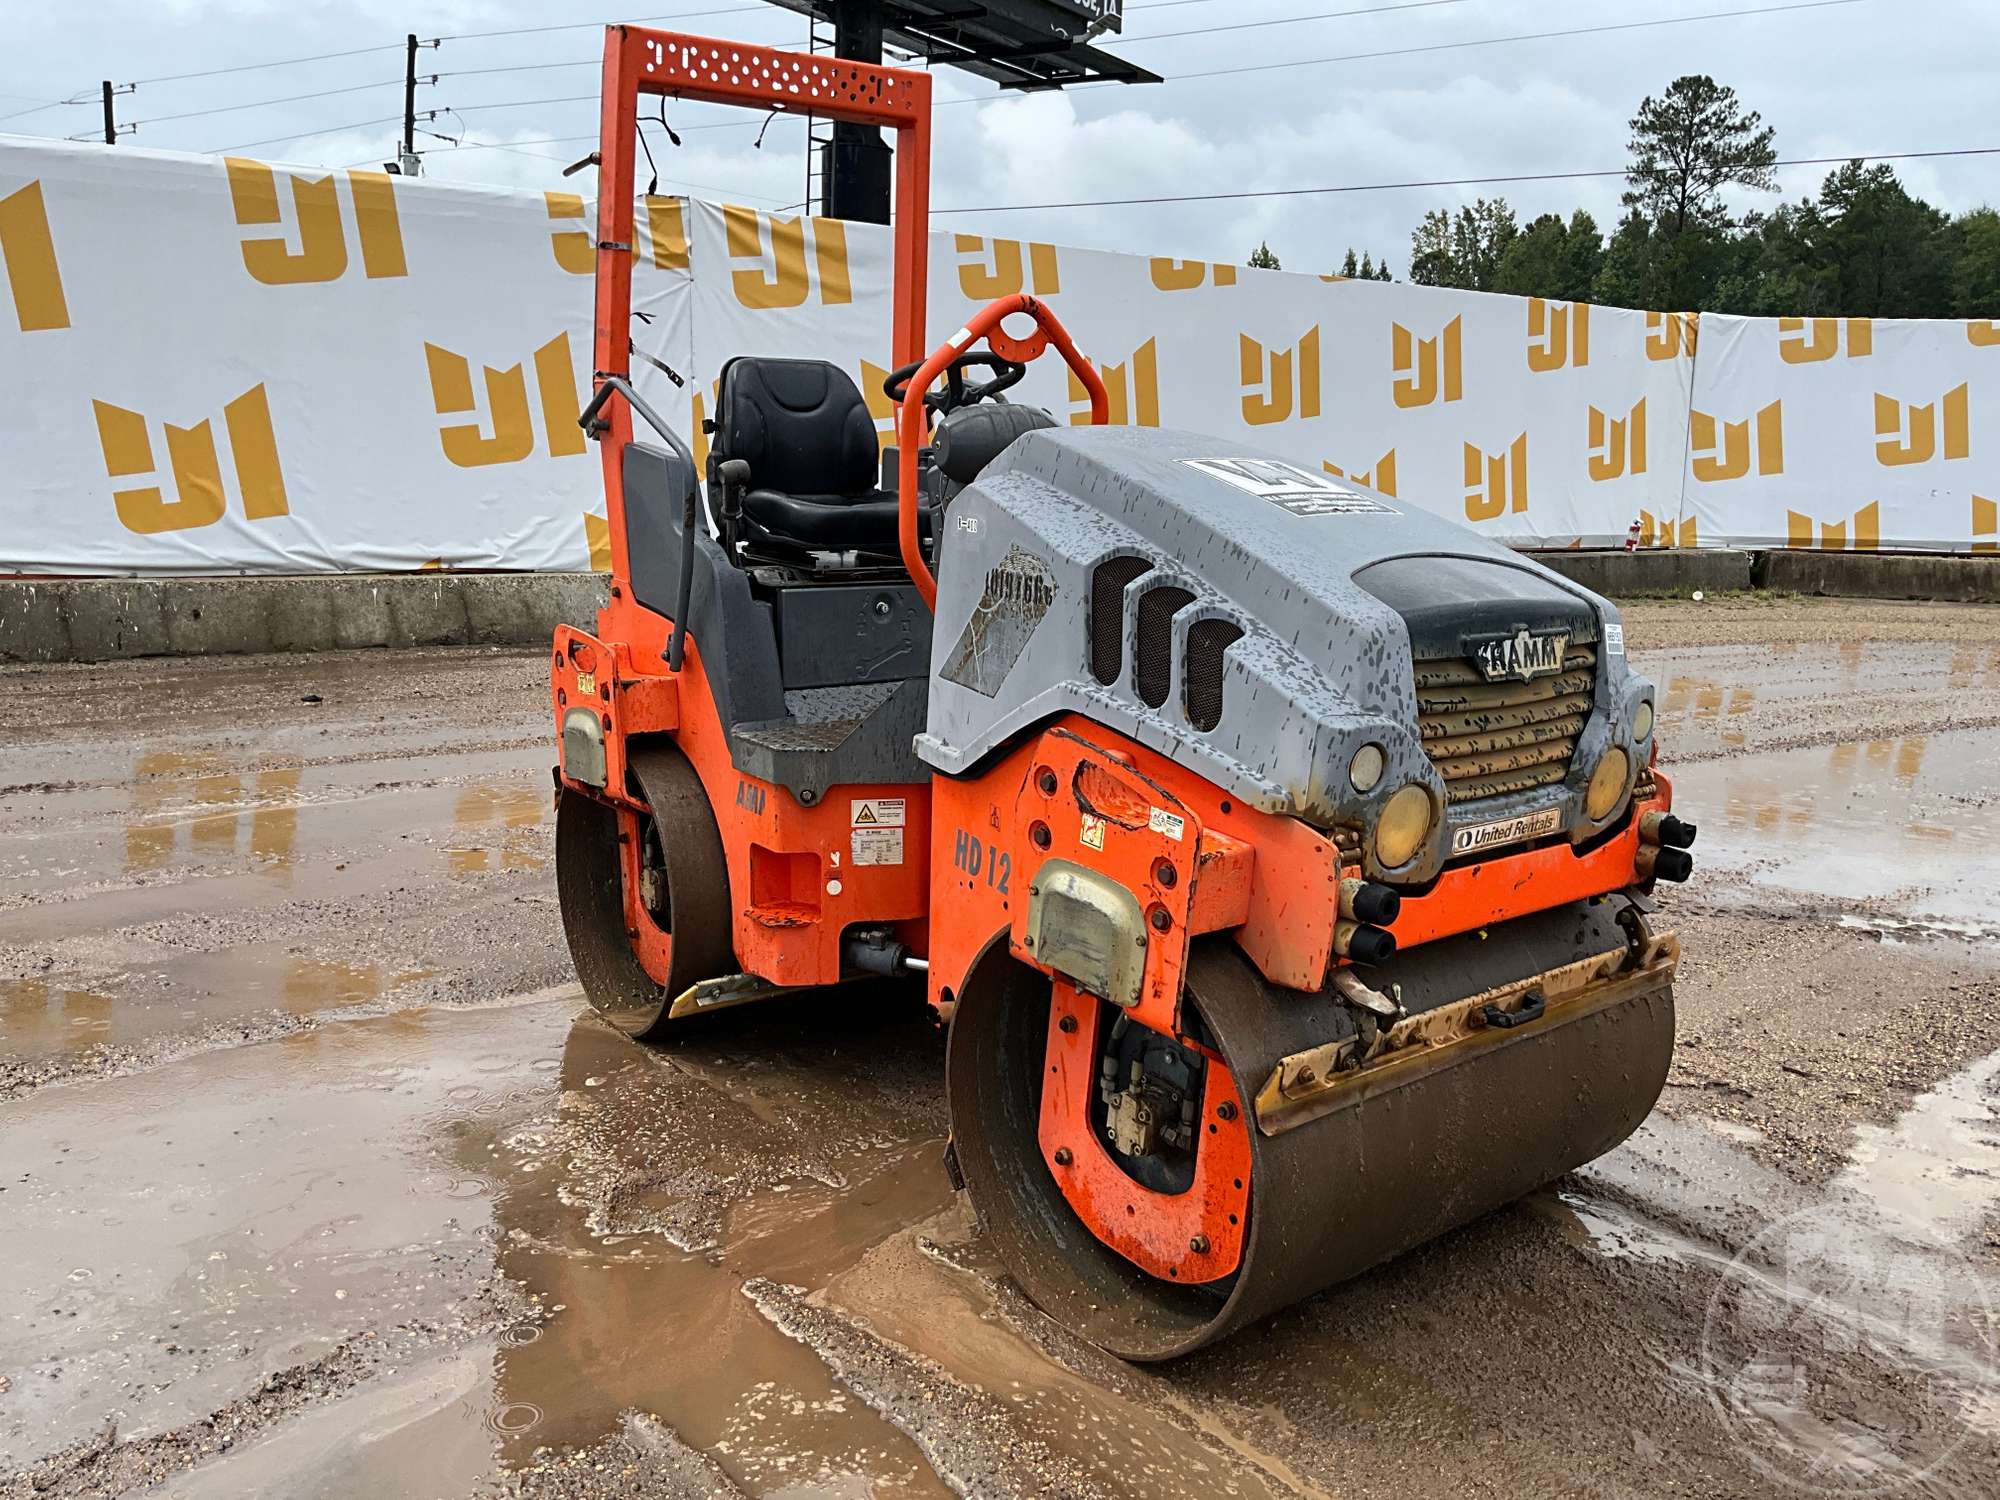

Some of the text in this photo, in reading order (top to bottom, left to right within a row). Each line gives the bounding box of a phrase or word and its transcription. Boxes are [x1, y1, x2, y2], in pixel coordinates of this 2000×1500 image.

[1474, 814, 1553, 845] United Rentals
[954, 828, 982, 876] HD
[987, 845, 1011, 896] 12
